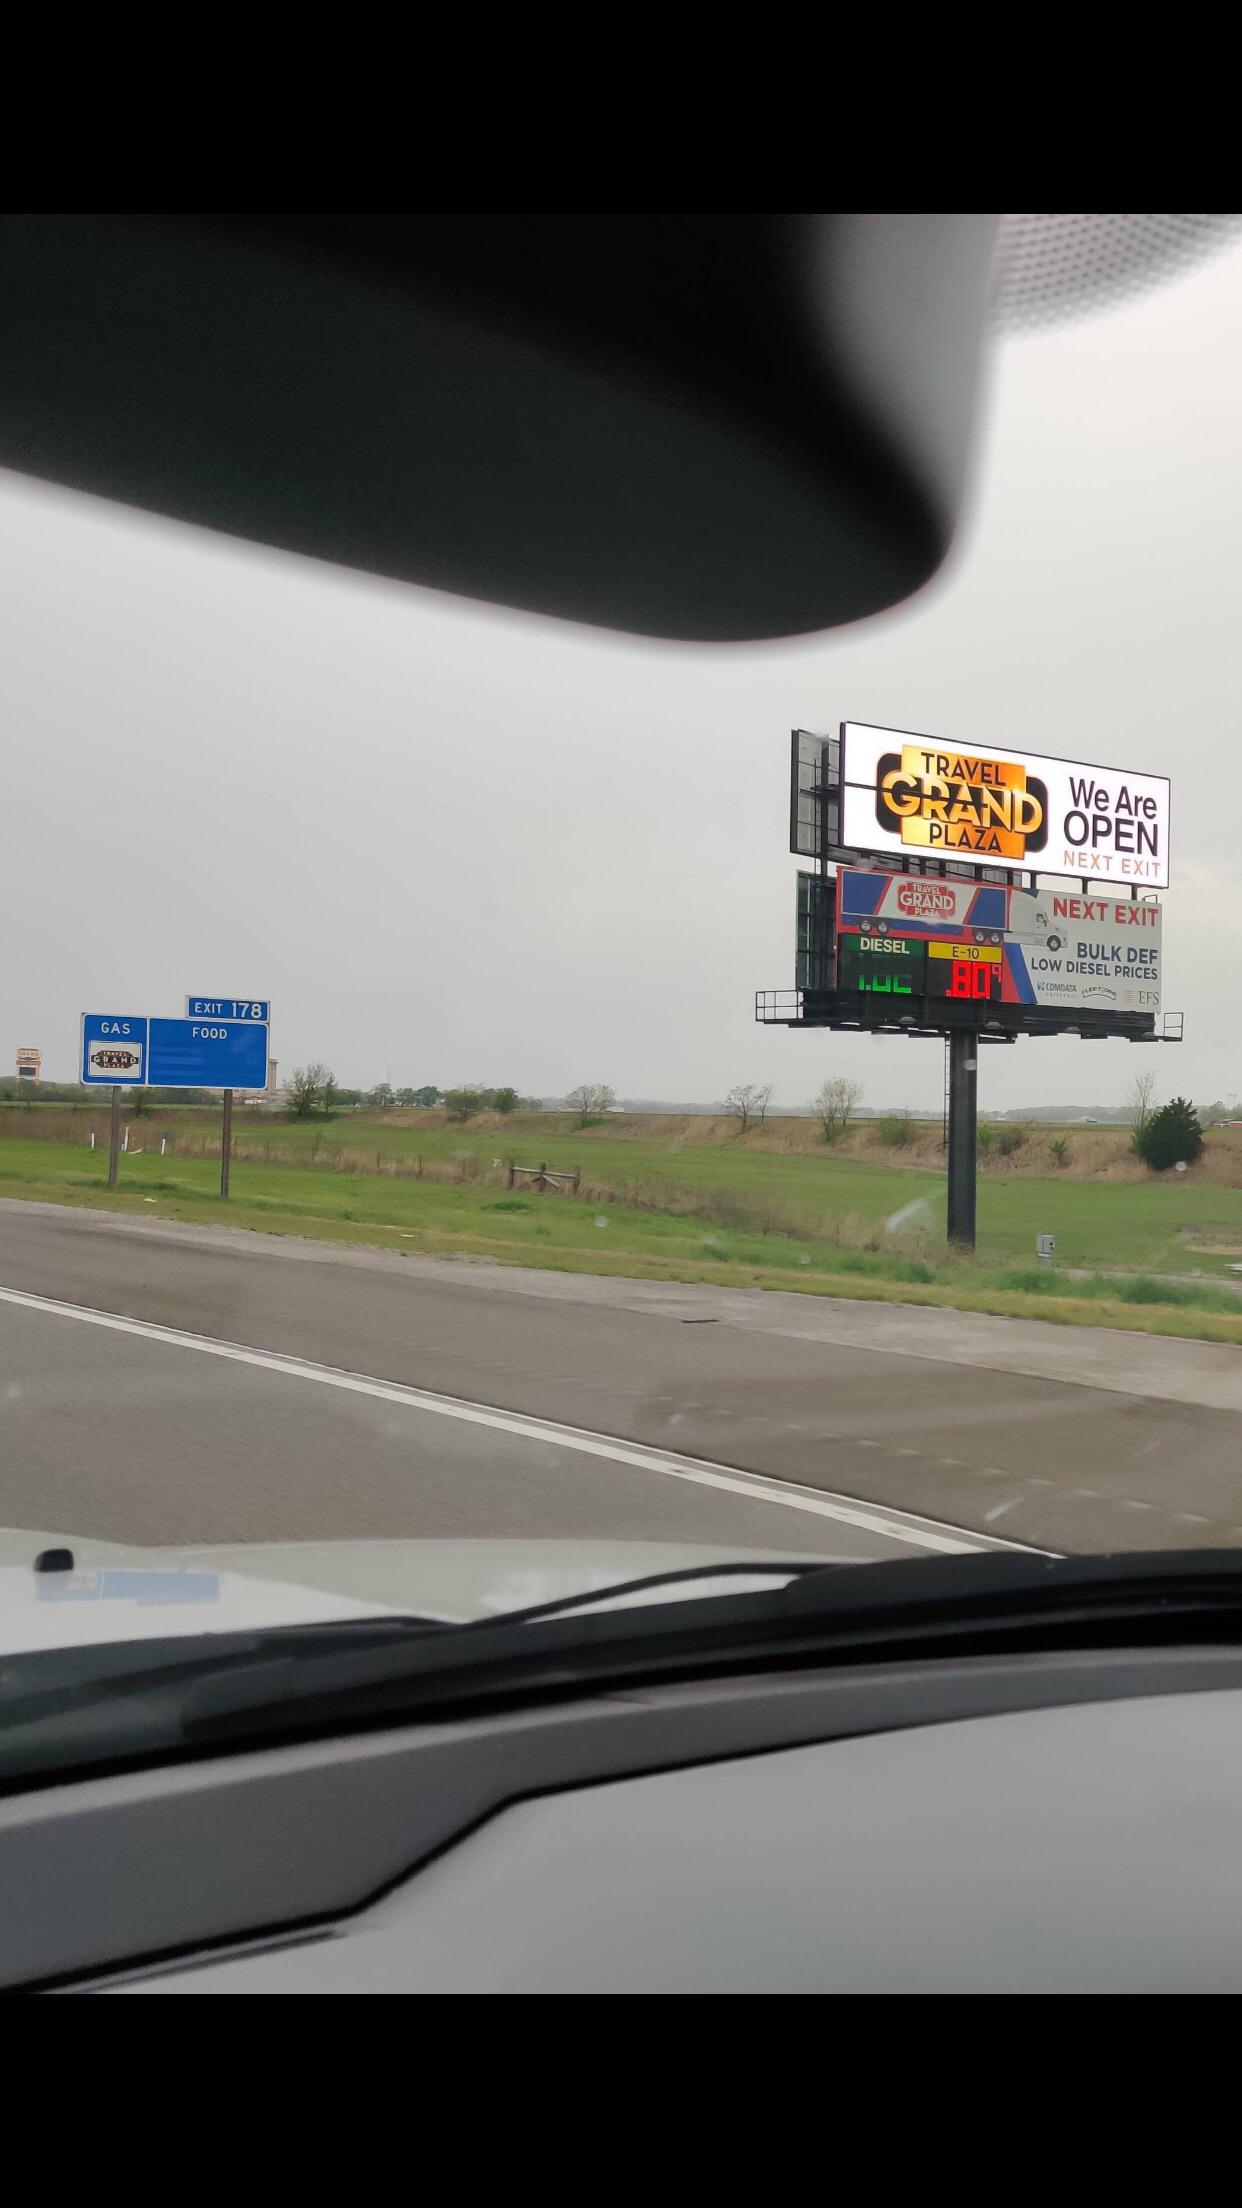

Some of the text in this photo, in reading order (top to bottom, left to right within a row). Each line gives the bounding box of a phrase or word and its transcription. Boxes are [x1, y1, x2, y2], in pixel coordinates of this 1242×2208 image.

[921, 751, 1006, 787] TRAVEL
[882, 771, 1043, 833] GRAND
[1069, 776, 1157, 819] We Are
[929, 822, 1002, 853] PLAZA
[1063, 810, 1159, 856] OPEN
[1064, 850, 1161, 878] NEXT EXIT
[912, 883, 942, 896] TRAVEL
[900, 890, 954, 910] GRAND
[1054, 898, 1159, 927] NEXT EXIT
[860, 937, 911, 955] DIESEL
[952, 946, 980, 960] E-10
[1076, 942, 1158, 966] BULK DEF
[1031, 957, 1158, 981] LOW DIESEL PRICES
[1046, 982, 1077, 994] COMDATA
[1139, 990, 1160, 1006] EFS
[195, 1001, 263, 1019] EXIT 178
[101, 1022, 131, 1035] GAS
[192, 1027, 228, 1040] FOOD
[93, 1055, 137, 1064] GRAND
